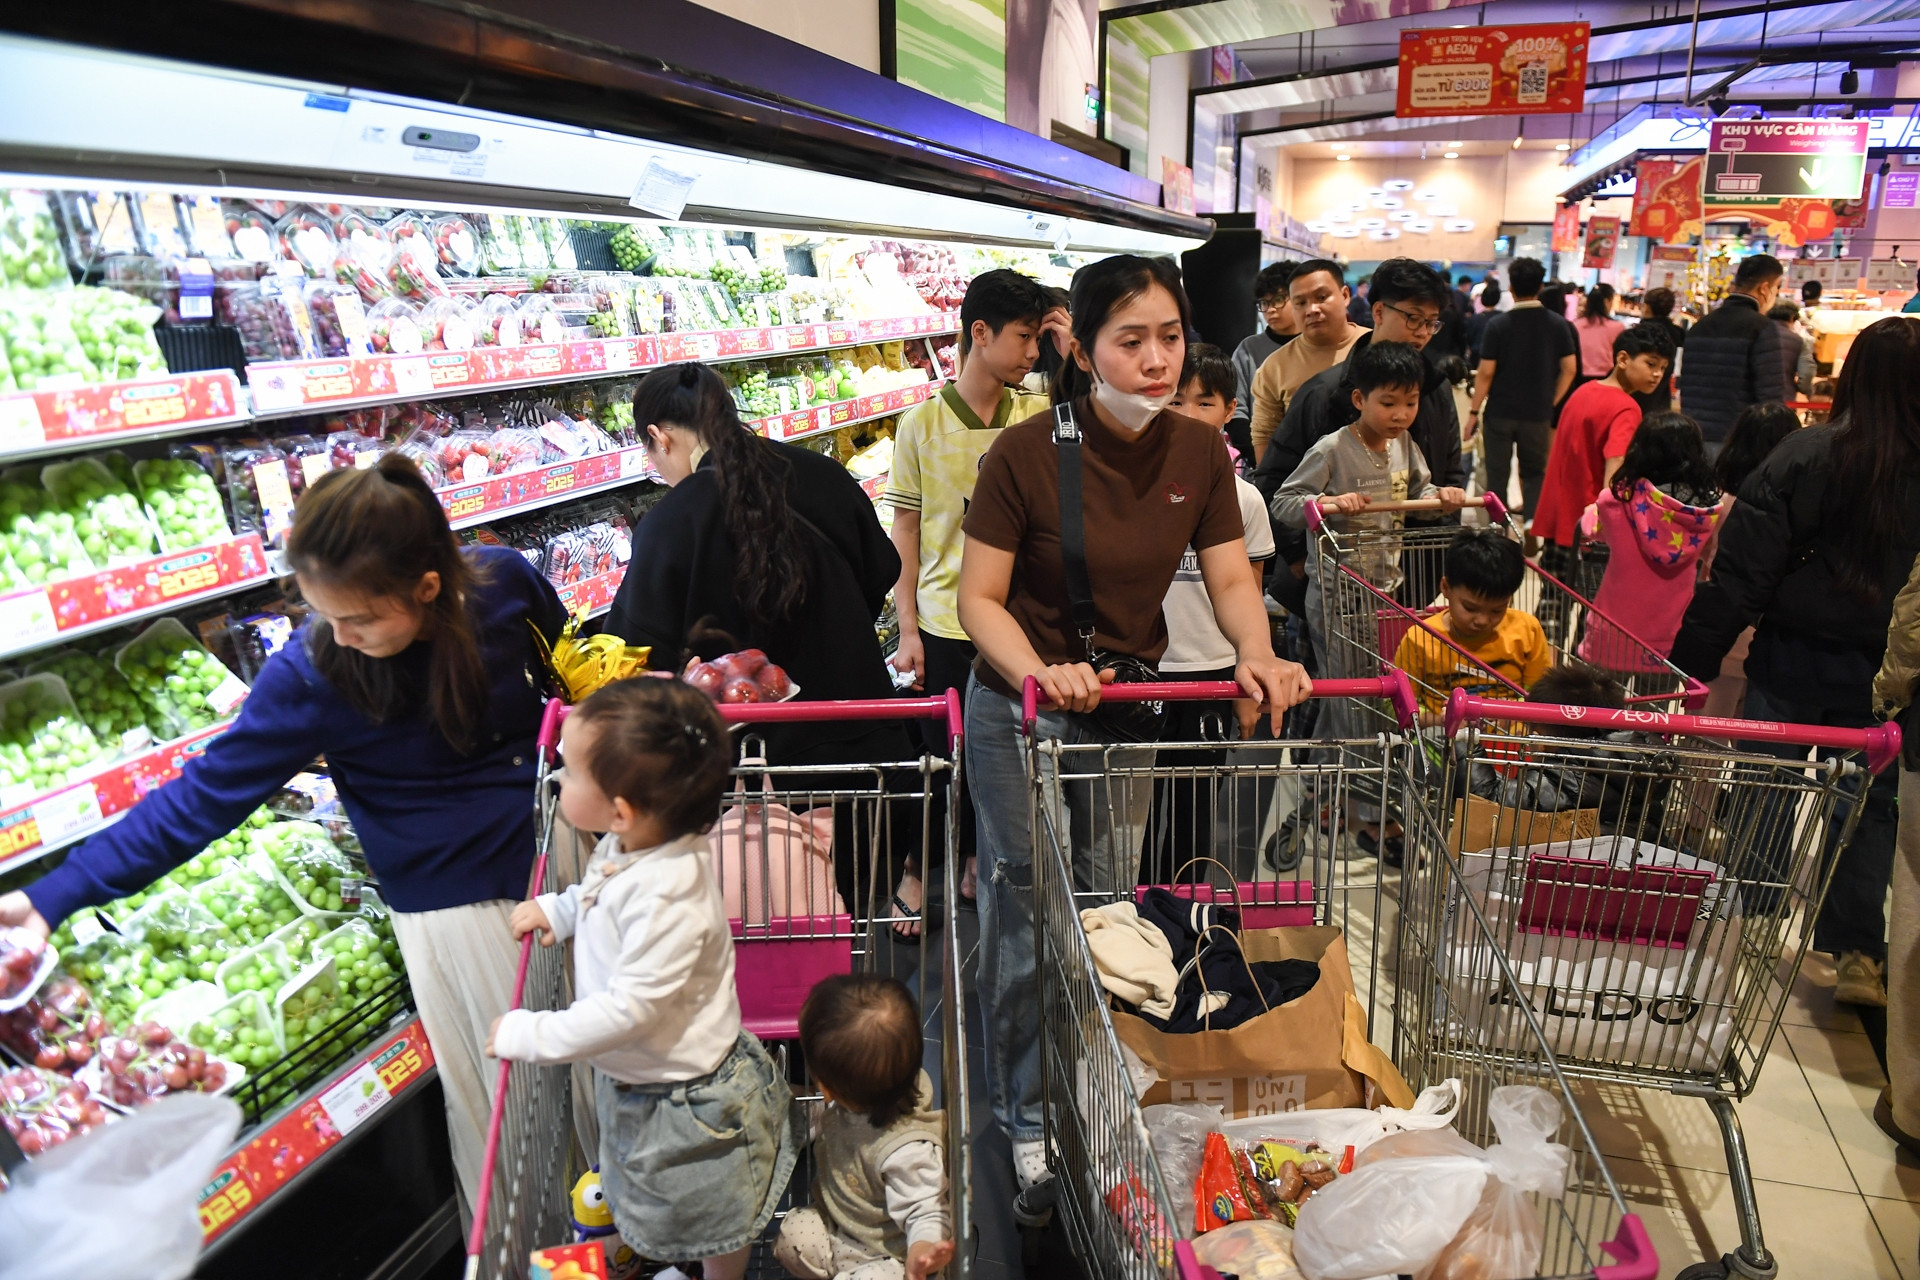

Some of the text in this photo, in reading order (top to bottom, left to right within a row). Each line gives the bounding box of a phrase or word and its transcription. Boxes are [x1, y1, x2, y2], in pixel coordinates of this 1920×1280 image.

[1446, 43, 1478, 55] AEON
[1515, 36, 1560, 53] 100%
[1454, 78, 1489, 93] 600K
[1721, 124, 1751, 136] KHU
[1753, 123, 1783, 138] VỰC
[1784, 122, 1816, 136] CÂN
[123, 396, 187, 427] 2025
[793, 419, 810, 432] 2025
[546, 473, 575, 493] 2025
[450, 495, 485, 518] 2025
[159, 563, 220, 598] 2025
[1717, 719, 1726, 727] NOT
[1726, 720, 1746, 729] ALLOWED
[1760, 723, 1779, 731] TROLLEY
[1489, 986, 1700, 1026] ALDO
[1255, 1079, 1294, 1099] UNI
